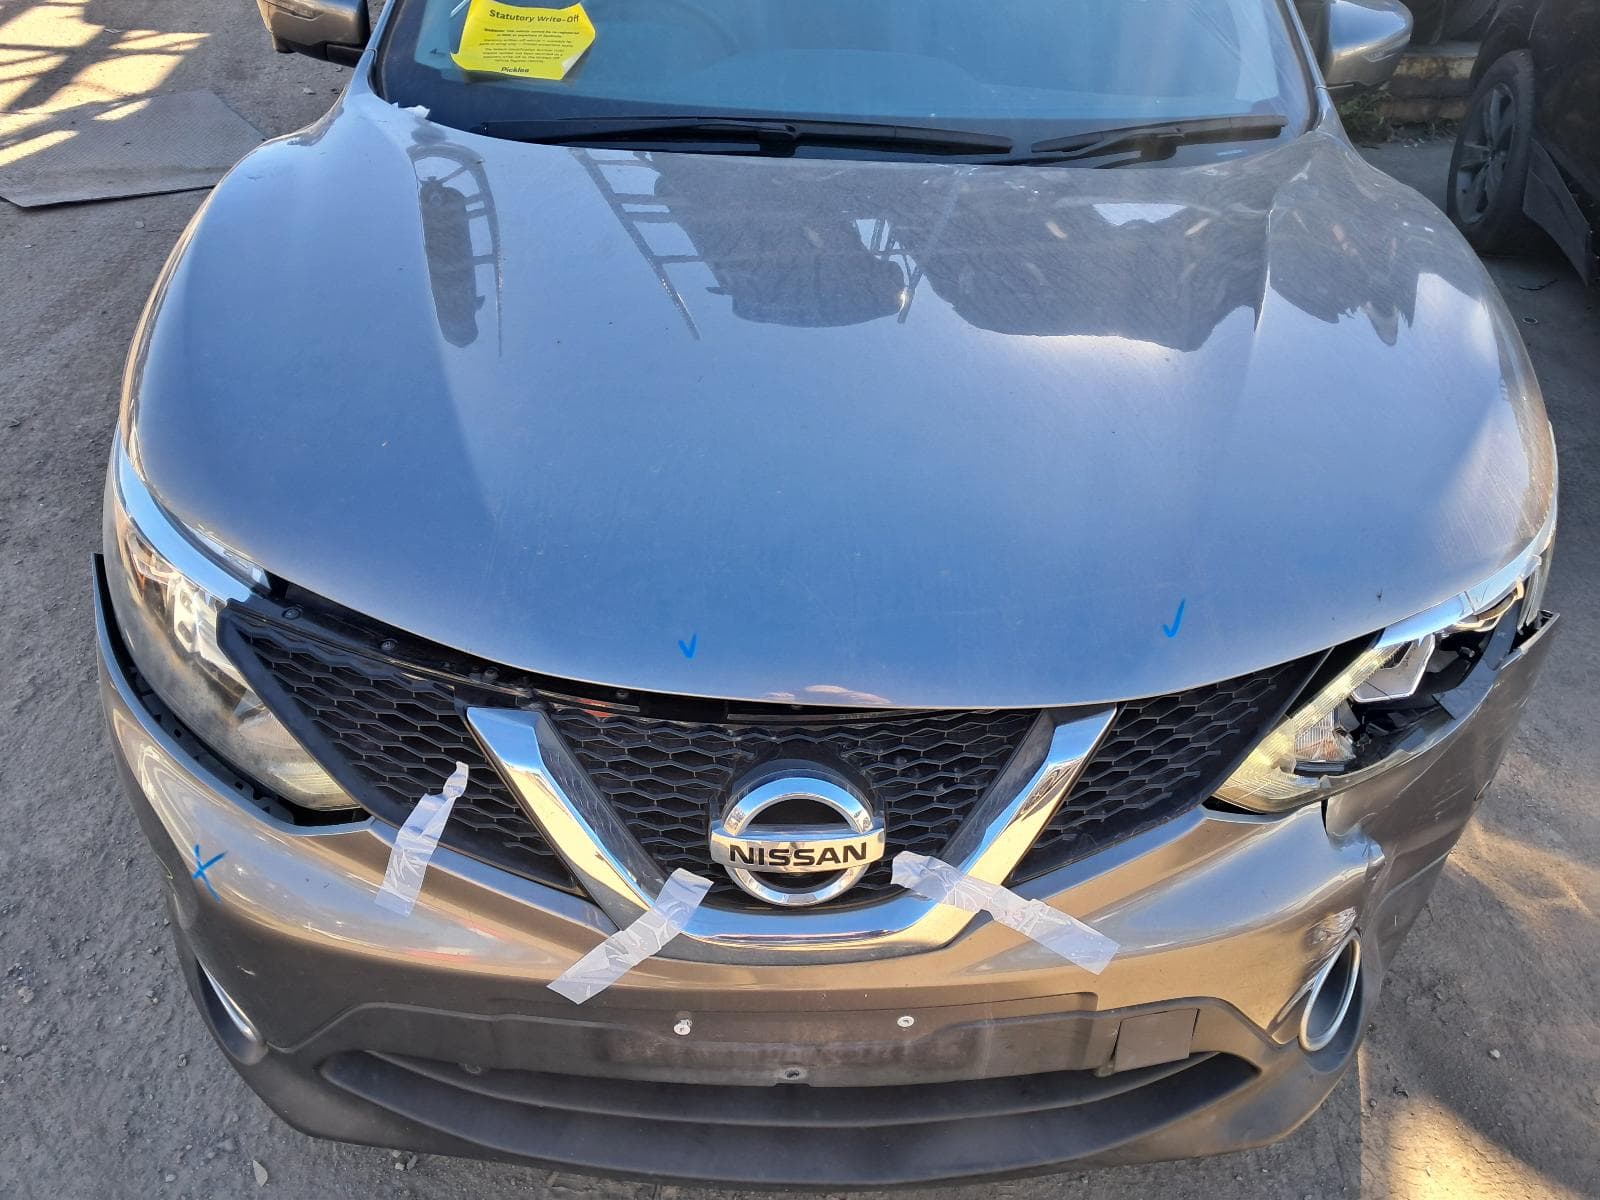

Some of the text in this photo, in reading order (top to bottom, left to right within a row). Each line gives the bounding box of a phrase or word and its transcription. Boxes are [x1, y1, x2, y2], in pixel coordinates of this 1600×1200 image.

[489, 9, 580, 23] Statutory Write-Off
[729, 842, 868, 867] NISSAN
